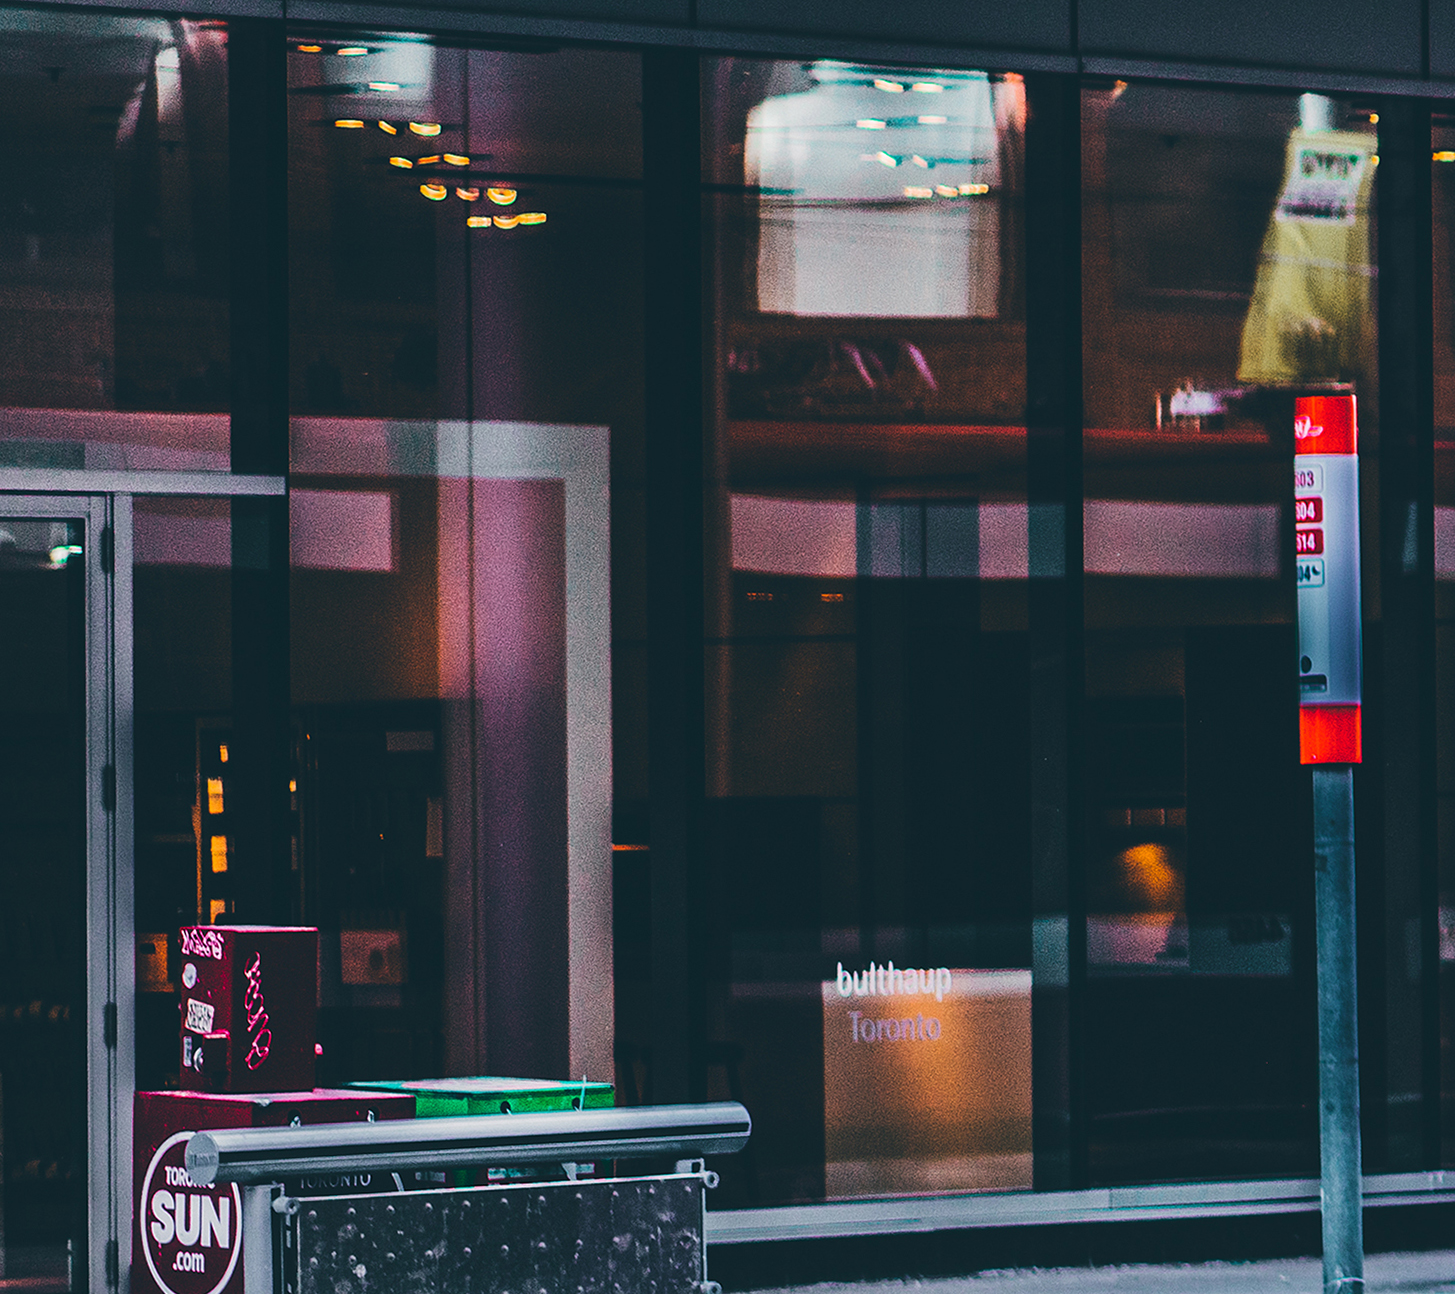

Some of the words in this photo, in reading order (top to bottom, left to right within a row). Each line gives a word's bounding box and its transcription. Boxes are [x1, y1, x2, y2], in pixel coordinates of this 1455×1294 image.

[836, 960, 953, 1002] bulthaup
[849, 1011, 942, 1044] Toronto
[164, 1165, 216, 1190] TORO
[151, 1189, 231, 1249] SUN
[172, 1251, 206, 1274] .com
